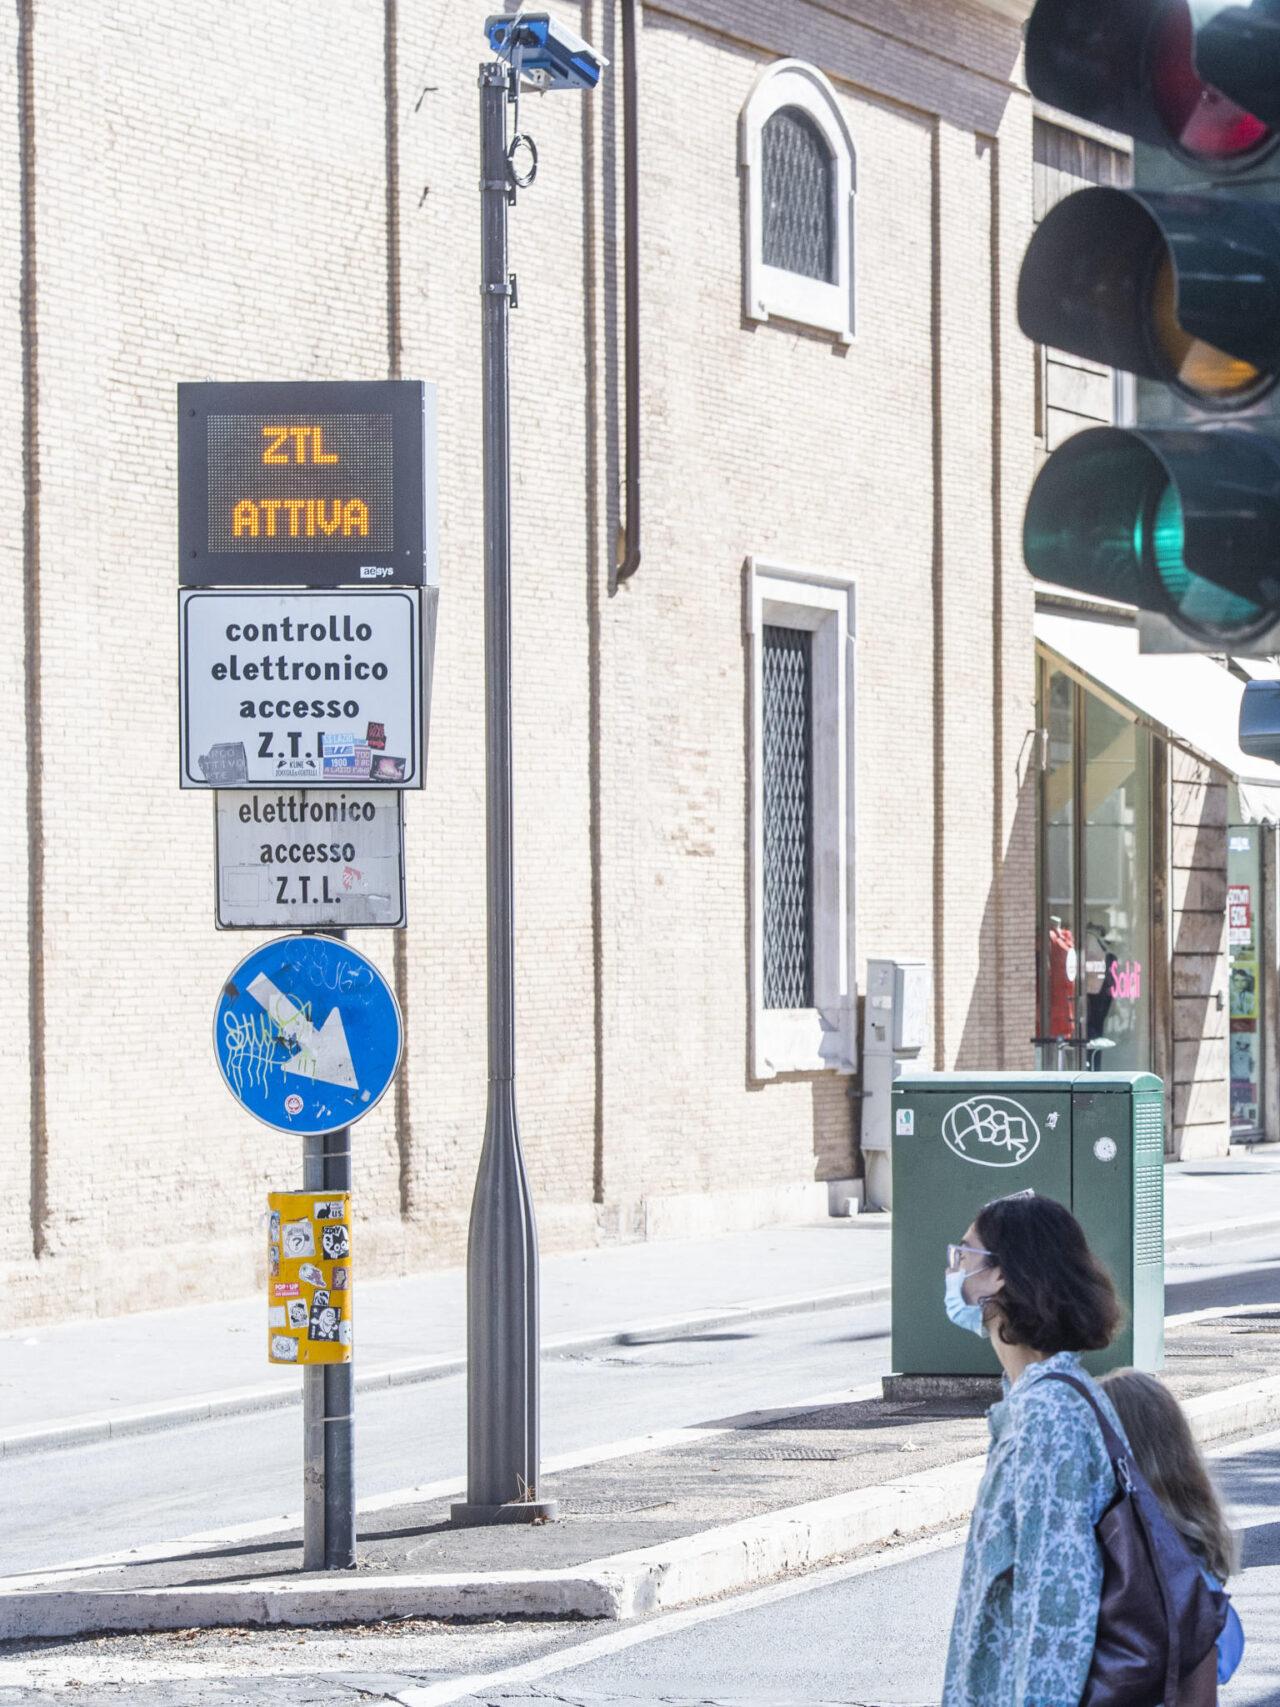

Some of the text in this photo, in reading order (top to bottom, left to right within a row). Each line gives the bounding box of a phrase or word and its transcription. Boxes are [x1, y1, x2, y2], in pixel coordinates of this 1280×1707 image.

[261, 425, 339, 465] ZTL
[231, 499, 370, 537] ATTIVA
[361, 565, 394, 578] aesys
[225, 615, 373, 642] controllo
[211, 654, 389, 681] elettronico
[239, 699, 360, 719] accesso
[239, 794, 376, 823] elettronico
[260, 843, 356, 863] accesso
[276, 875, 341, 904] Z.T.L.
